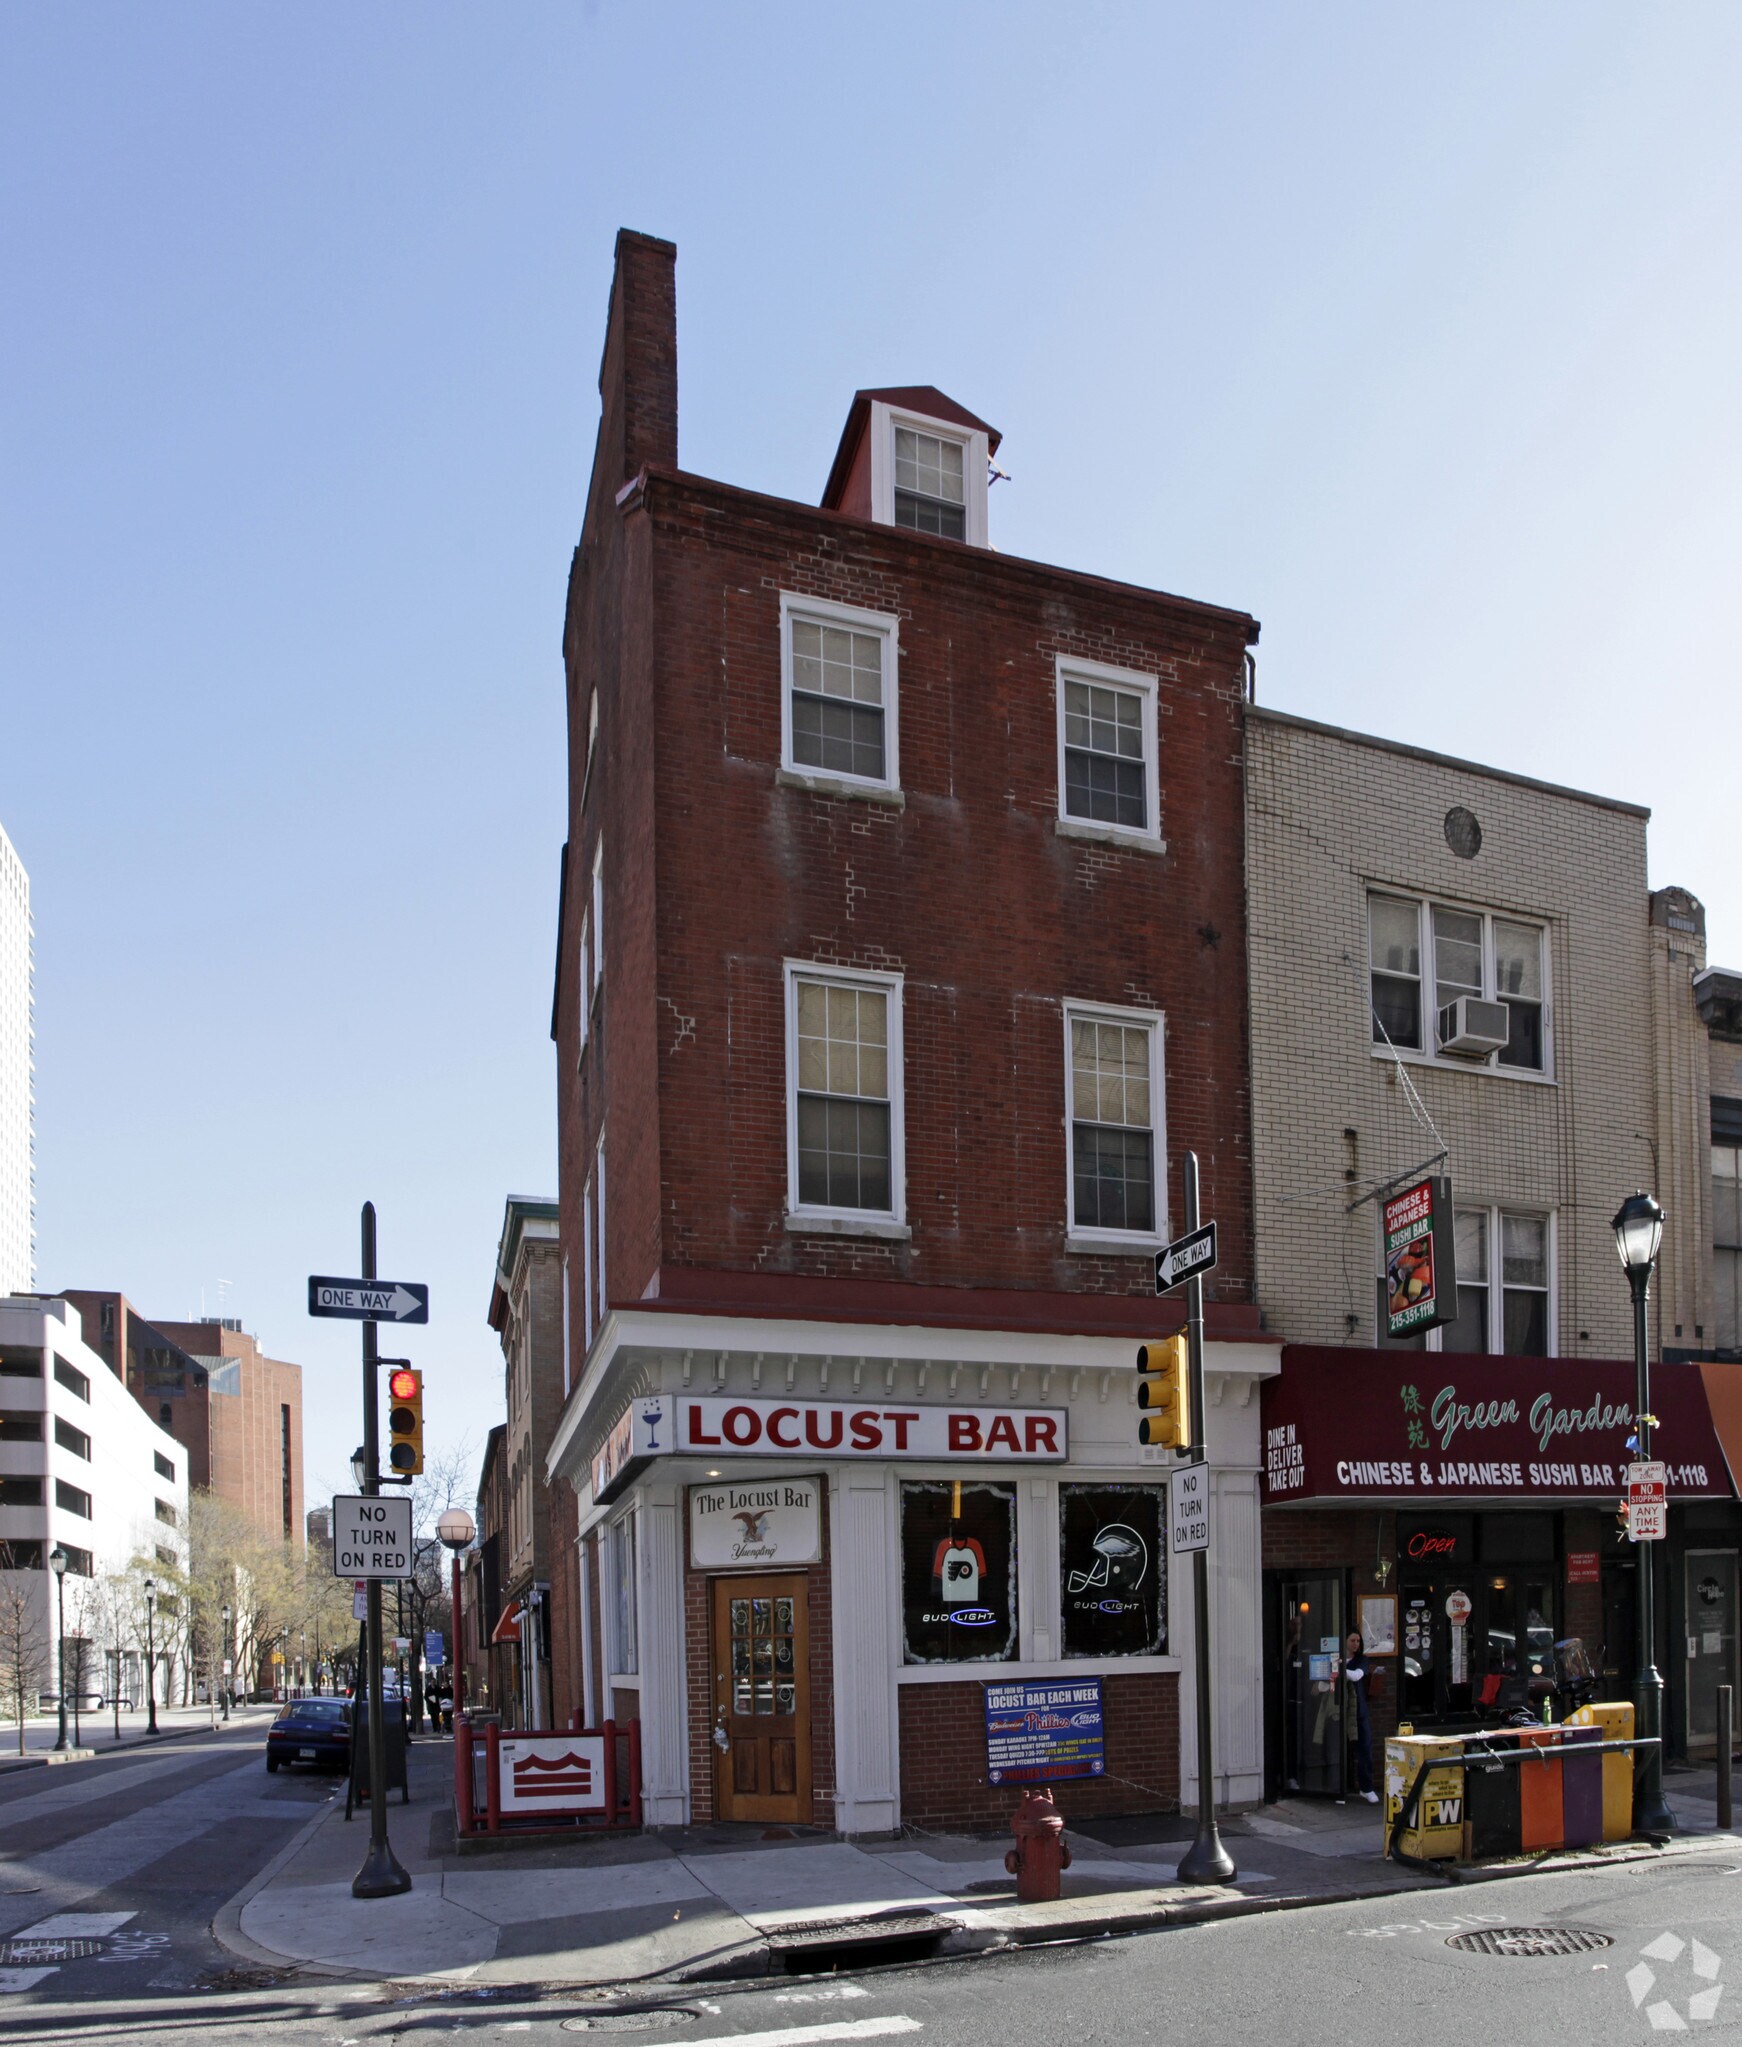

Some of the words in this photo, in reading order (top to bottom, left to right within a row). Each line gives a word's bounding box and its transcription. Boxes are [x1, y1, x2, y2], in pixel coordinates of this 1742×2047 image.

[1386, 1192, 1421, 1219] CHINESE
[1423, 1189, 1429, 1200] &
[1389, 1201, 1429, 1231] JAPANESE
[1390, 1227, 1412, 1248] SUSHI
[1413, 1218, 1429, 1236] BAR
[1172, 1251, 1189, 1273] ONE
[1190, 1239, 1209, 1263] WAY
[322, 1289, 354, 1306] ONE
[360, 1292, 392, 1309] WAY
[1390, 1301, 1434, 1330] 215-351-1118
[1431, 1385, 1520, 1451] Green
[1530, 1392, 1633, 1452] Garden
[688, 1405, 920, 1451] LOCUST
[947, 1414, 1059, 1453] BAR
[1268, 1426, 1286, 1450] DINE
[1287, 1424, 1296, 1445] IN
[1268, 1444, 1303, 1471] DELIVER
[1268, 1469, 1287, 1492] TAKE
[1289, 1466, 1305, 1488] OUT
[1336, 1461, 1414, 1485] CHINESE
[1420, 1462, 1433, 1485] &
[1437, 1463, 1524, 1485] JAPANESE
[1528, 1463, 1578, 1486] SUSHI
[1580, 1464, 1616, 1486] BAR
[1183, 1475, 1197, 1493] NO
[1640, 1484, 1653, 1495] NO
[696, 1494, 725, 1515] The
[729, 1489, 779, 1509] Locust
[784, 1487, 812, 1508] Bar
[1180, 1498, 1202, 1518] TURN
[1631, 1494, 1663, 1503] STOPPING
[359, 1507, 386, 1522] NO
[1636, 1506, 1658, 1516] ANY
[1635, 1517, 1659, 1527] TIME
[350, 1529, 396, 1545] TURN
[1176, 1526, 1188, 1543] ON
[1190, 1522, 1206, 1540] RED
[731, 1543, 777, 1560] Yuengling
[1408, 1533, 1457, 1559] Open
[341, 1552, 364, 1567] ON
[372, 1552, 406, 1568] RED
[1697, 1584, 1720, 1593] Circle
[1073, 1601, 1098, 1609] BUD
[956, 1612, 995, 1620] LIGHT
[988, 1688, 1003, 1696] COME
[1003, 1687, 1016, 1695] JOIN
[988, 1696, 1024, 1708] LOCUST
[1026, 1692, 1046, 1705] BAR
[1048, 1691, 1072, 1703] EACH
[1073, 1689, 1099, 1701] WEEK
[988, 1721, 1024, 1731] Budweiser
[1025, 1711, 1071, 1731] Phillies
[1425, 1799, 1460, 1825] PW
